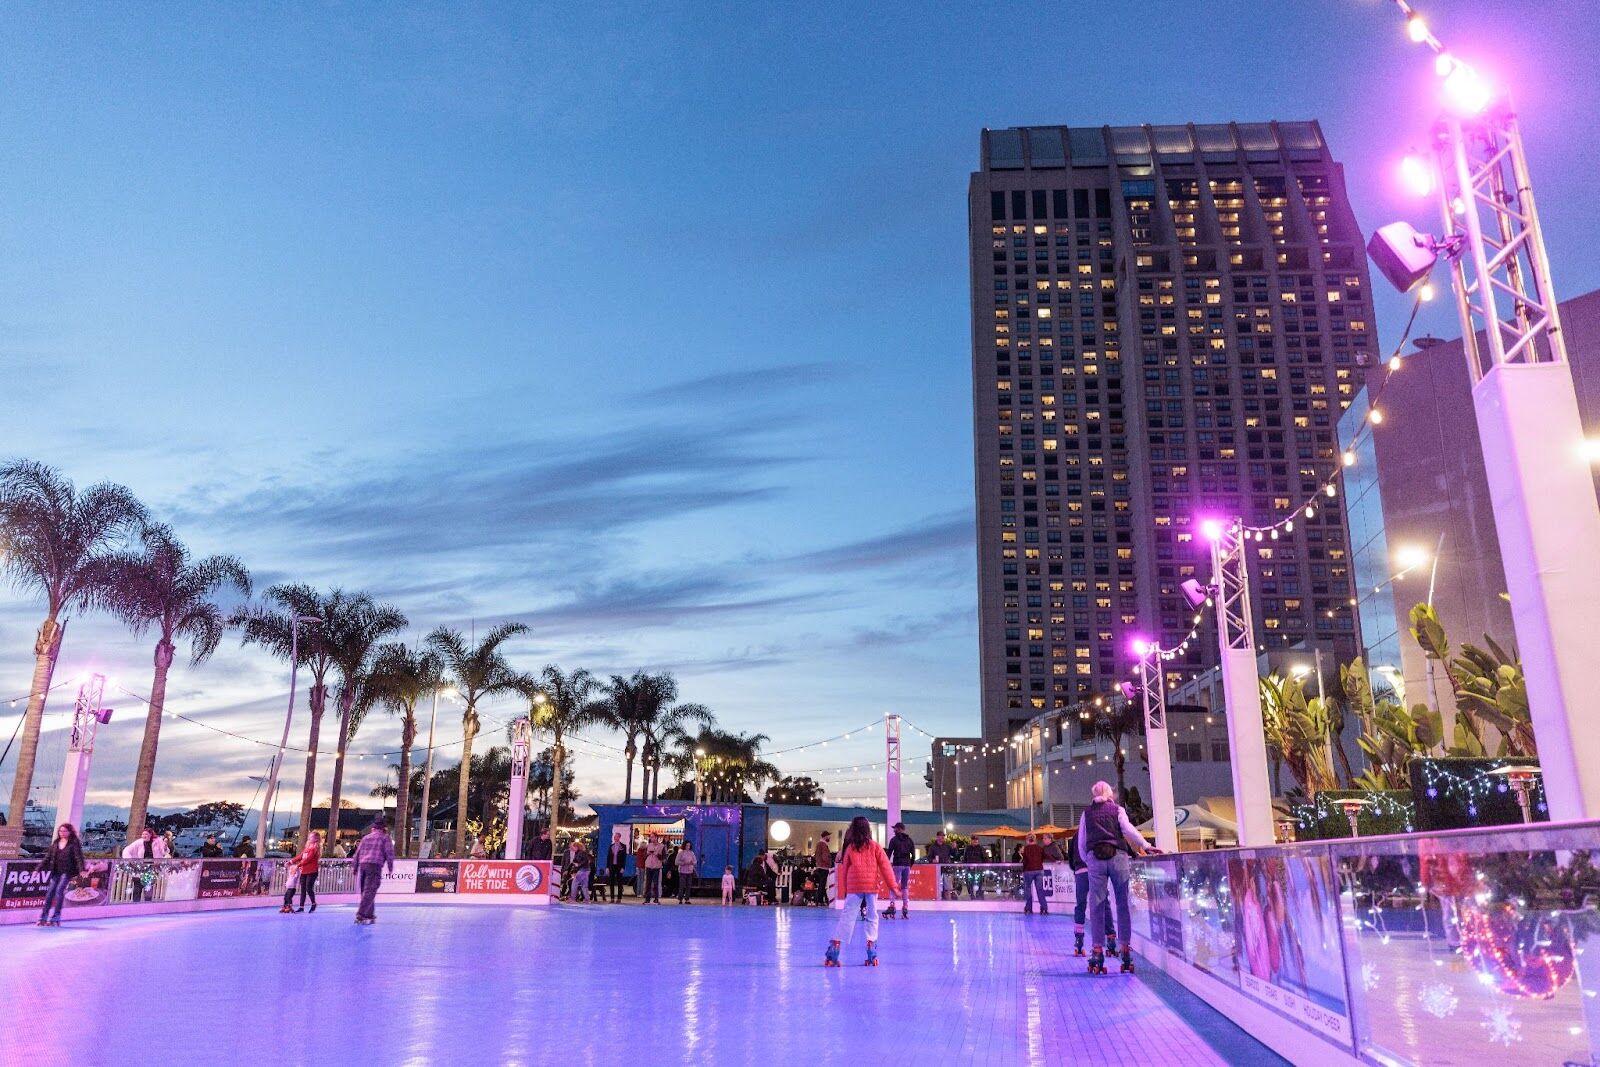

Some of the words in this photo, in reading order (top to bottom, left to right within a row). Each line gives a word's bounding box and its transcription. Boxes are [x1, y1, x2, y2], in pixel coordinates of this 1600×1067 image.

[6, 870, 51, 885] AGAV
[463, 864, 489, 879] Roll
[488, 868, 513, 879] WITH
[465, 879, 483, 890] THE
[485, 879, 510, 890] TIDE.
[5, 900, 21, 908] Baja
